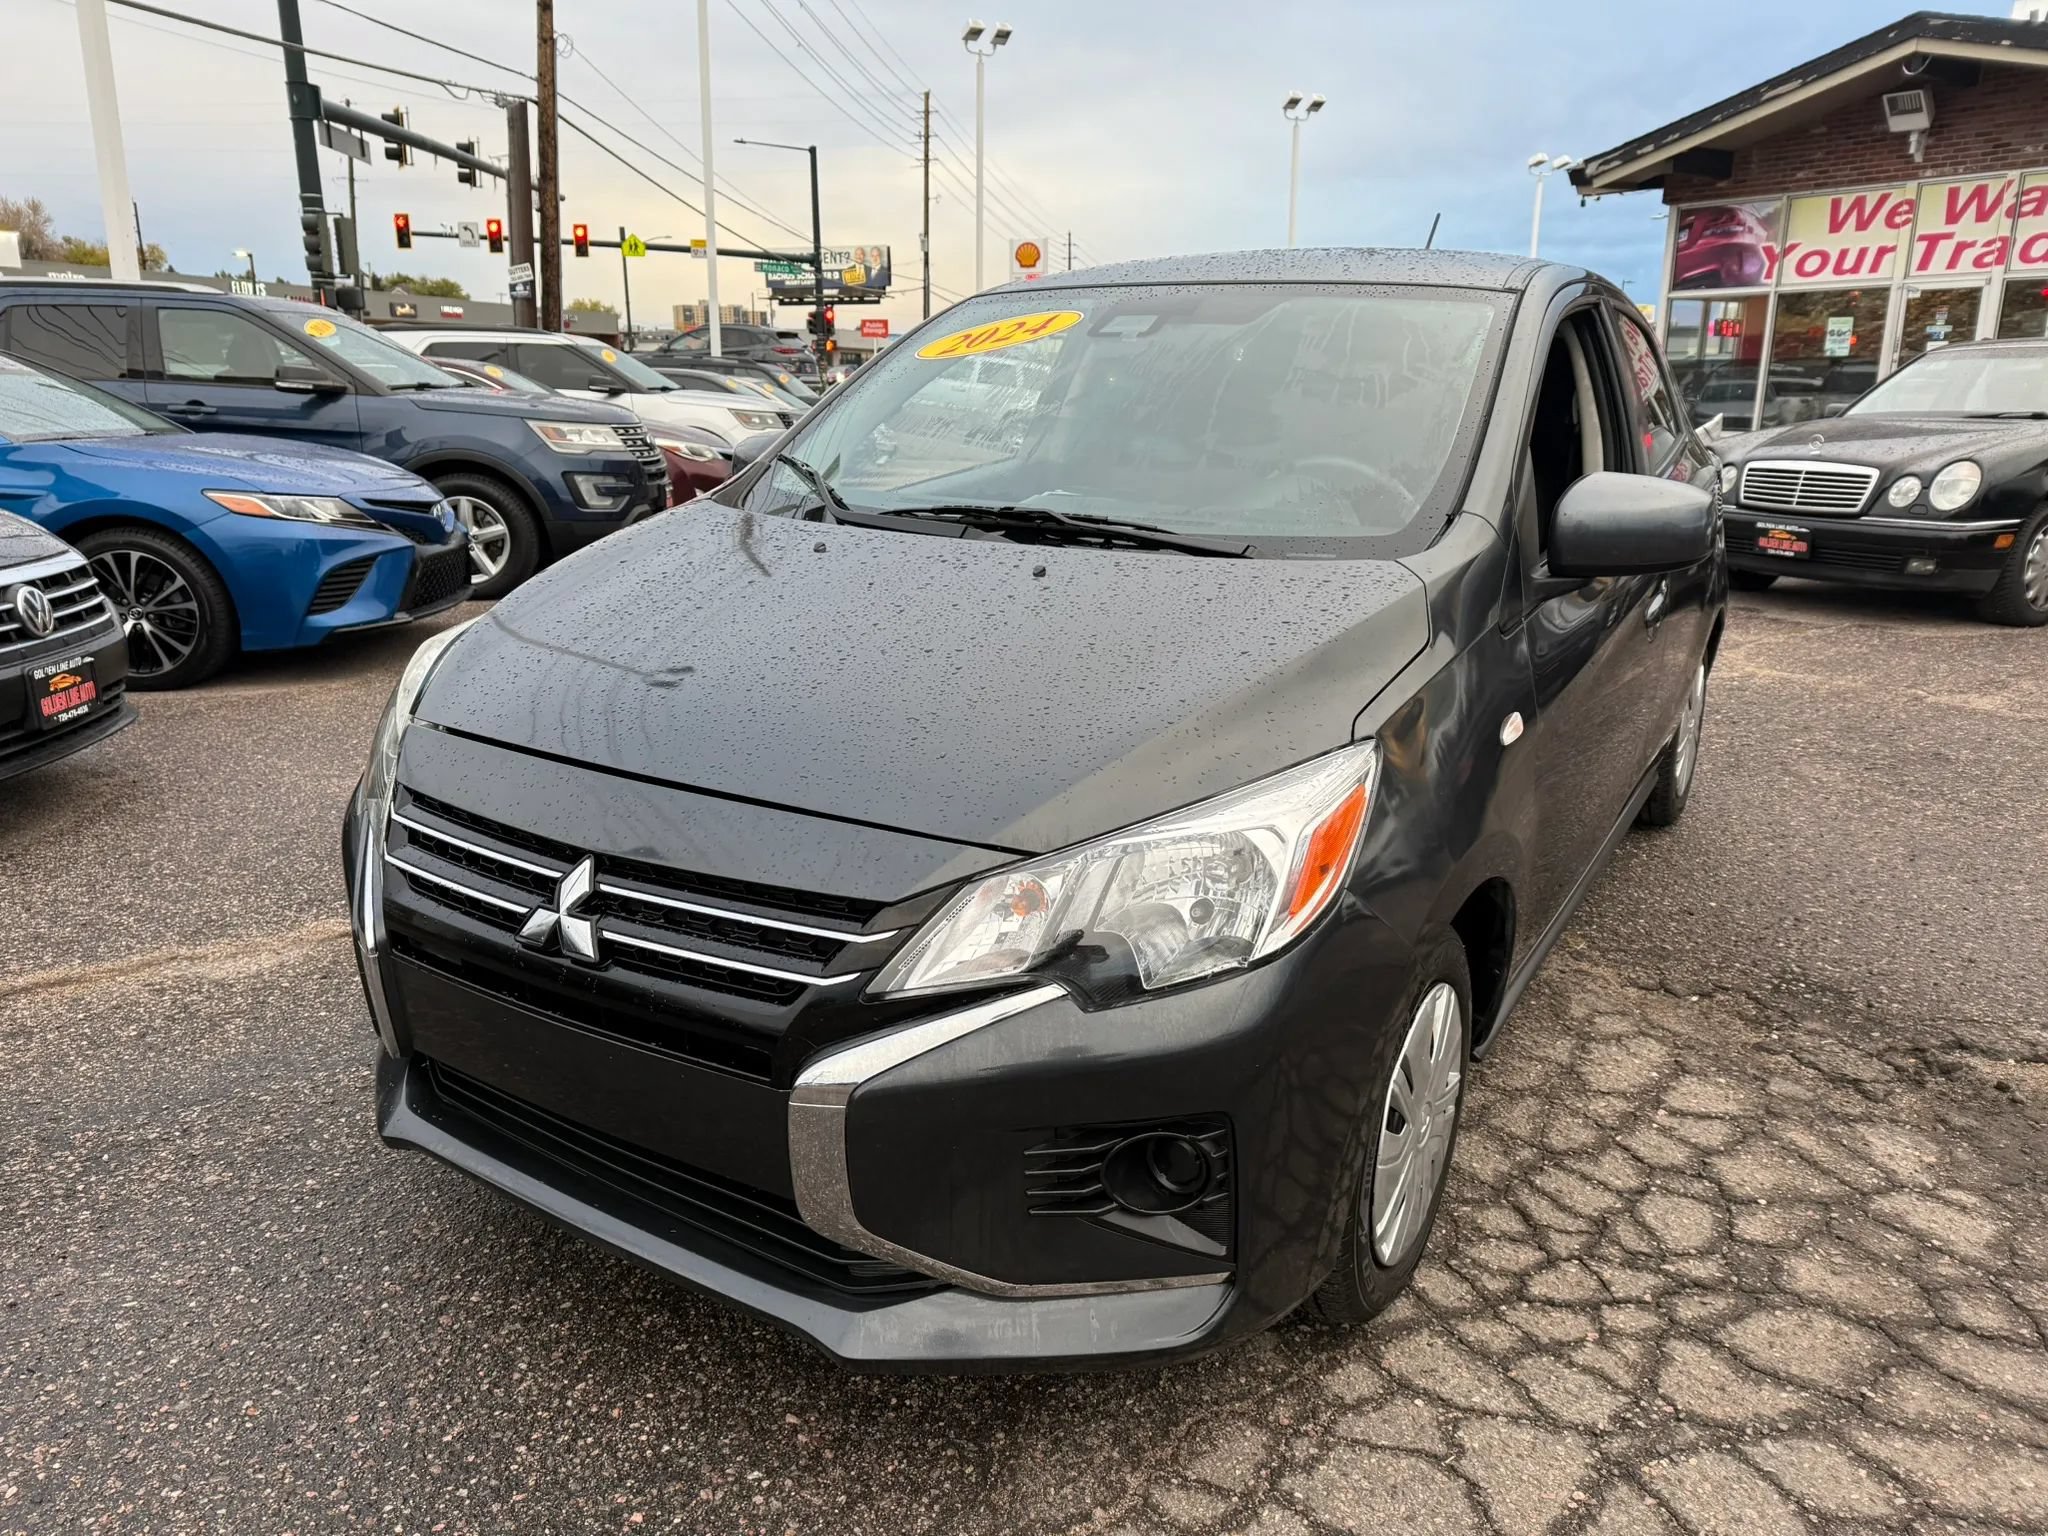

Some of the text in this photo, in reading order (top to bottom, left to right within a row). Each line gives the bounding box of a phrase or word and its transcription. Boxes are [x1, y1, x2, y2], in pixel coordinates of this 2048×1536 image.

[1828, 179, 2048, 234] We Wa
[1762, 242, 1897, 280] Your
[936, 314, 1061, 356] 2024
[33, 656, 82, 680] GOLDEN LINE AUTO
[41, 680, 96, 717] GOLDEN LINE AUTO
